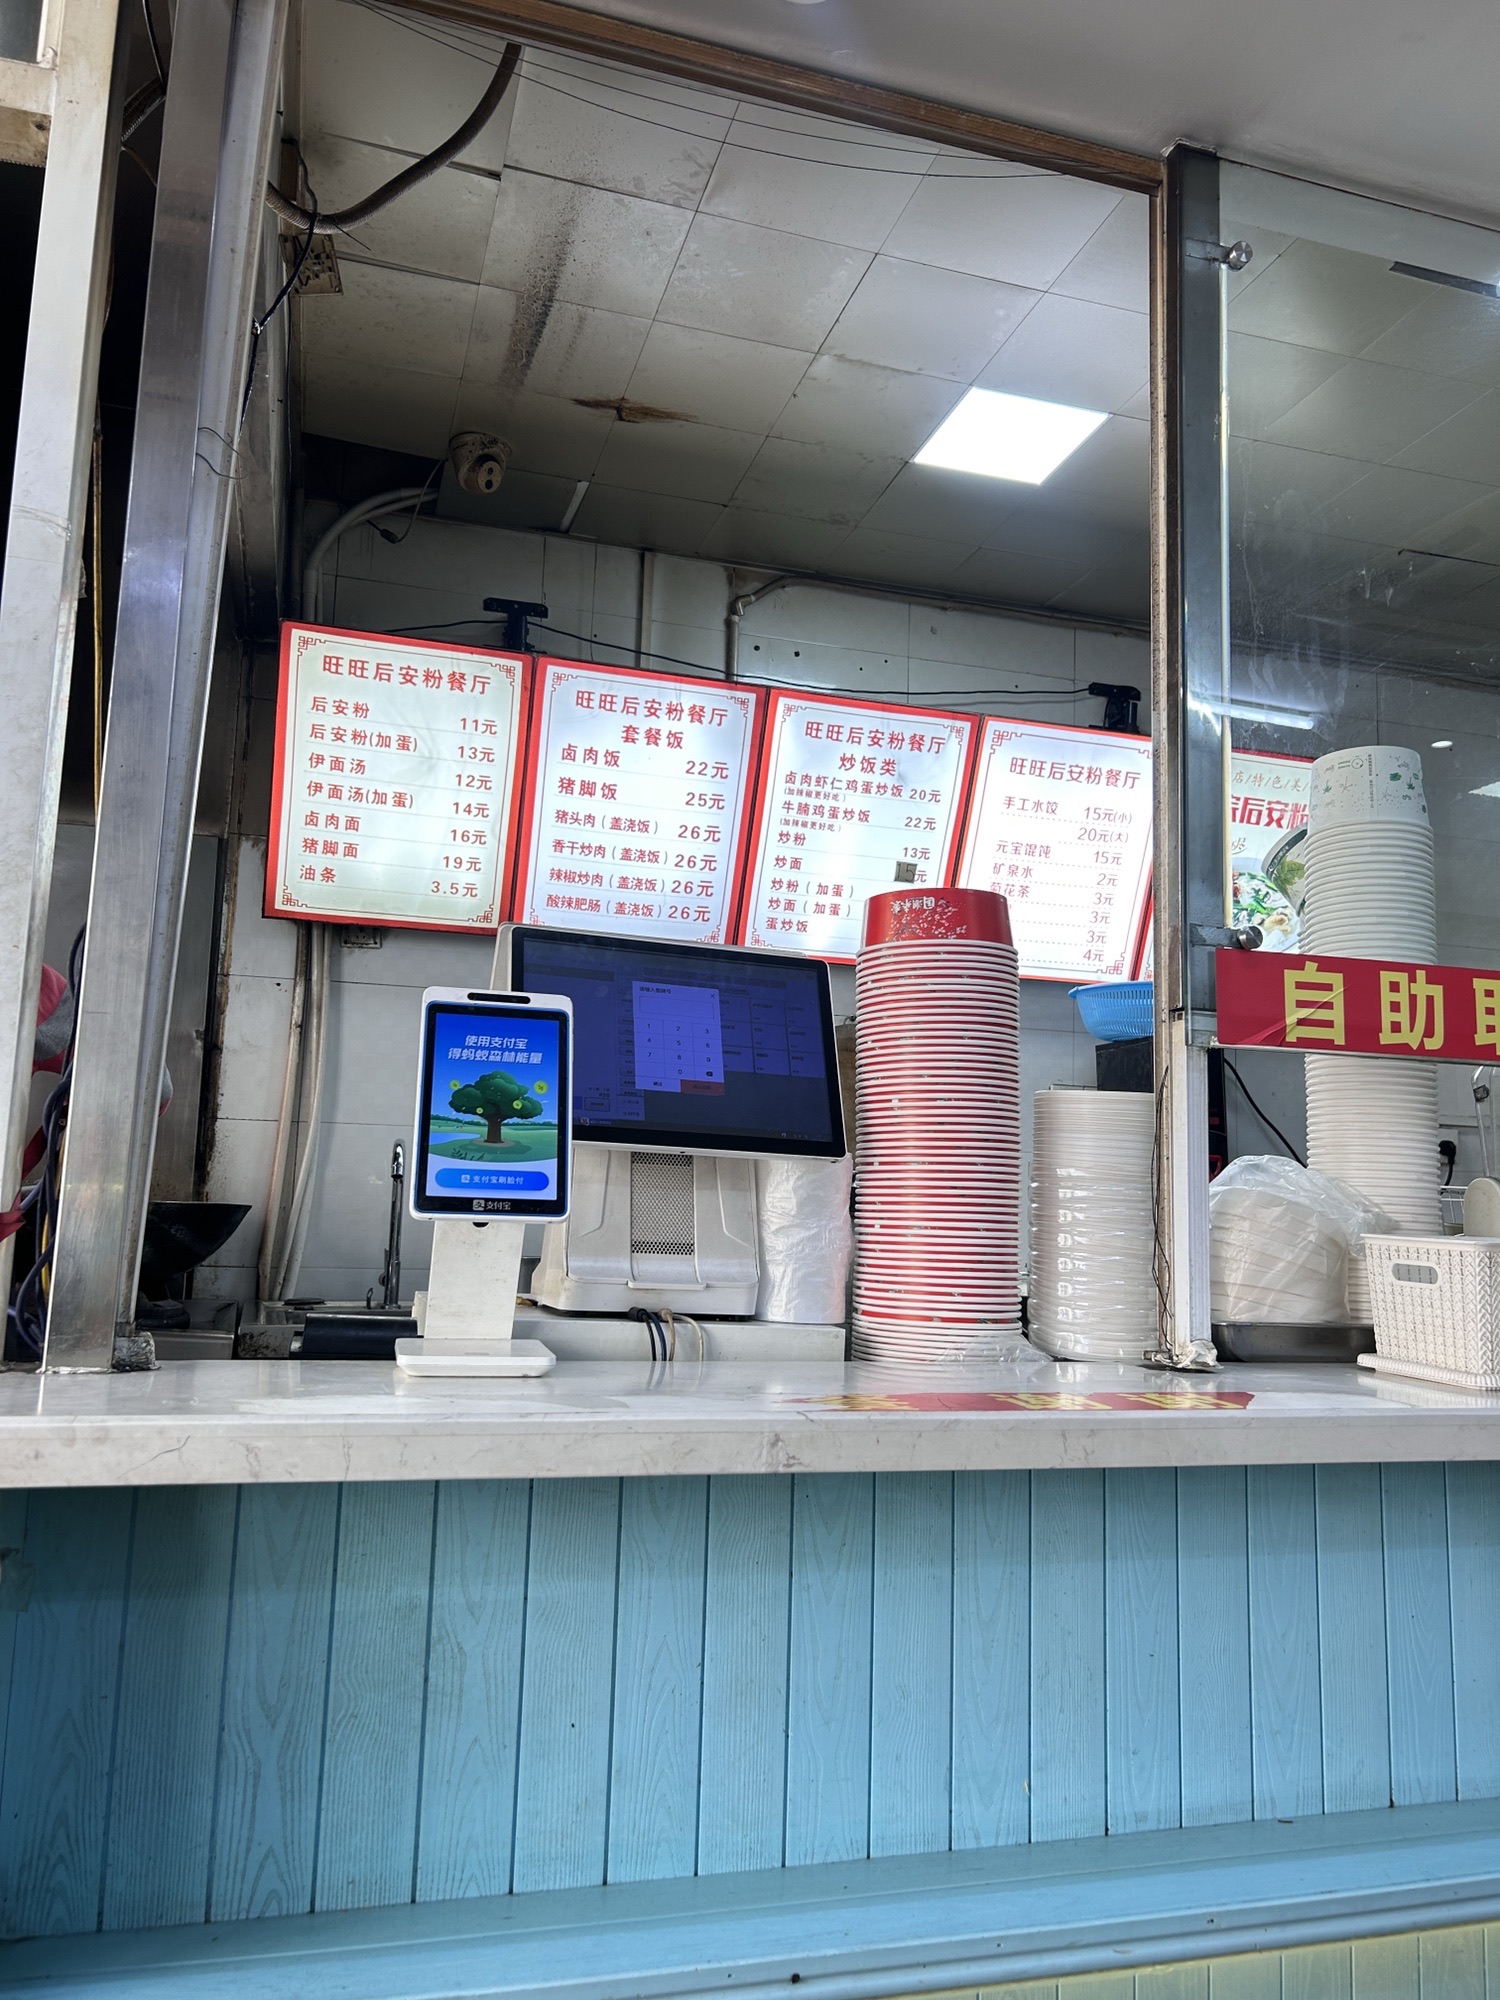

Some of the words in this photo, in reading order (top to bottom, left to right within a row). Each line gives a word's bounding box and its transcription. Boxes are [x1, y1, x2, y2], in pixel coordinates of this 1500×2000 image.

[322, 655, 491, 695] 旺旺后安粉餐厅
[310, 696, 370, 719] 后安粉
[460, 717, 497, 736] 11元
[575, 689, 728, 727] 旺旺后安粉餐厅
[309, 724, 418, 753] 后安粉(加蛋)
[457, 746, 495, 763] 13元
[621, 725, 684, 750] 套餐饭
[804, 721, 947, 755] 旺旺后安粉餐厅
[308, 752, 366, 775] 伊面汤
[455, 773, 493, 791] 12元
[561, 743, 621, 768] 卤肉饭
[686, 760, 729, 780] 22元
[838, 753, 897, 777] 炒饭类
[1009, 757, 1141, 790] 旺旺后安粉餐厅
[306, 780, 414, 809] 伊面汤(加蛋)
[452, 802, 490, 818] 14元
[558, 776, 618, 801] 猪脚饭
[685, 792, 725, 811] 25元
[784, 771, 903, 798] 卤肉虾仁鸡蛋炒饭
[909, 788, 942, 804] 20元
[781, 800, 871, 823] 牛腩鸡蛋炒饭
[904, 816, 937, 831] 22元
[1002, 795, 1059, 816] 手工水饺
[304, 811, 361, 832] 卤肉面
[450, 829, 487, 845] 16元
[678, 824, 722, 843] 26元
[302, 837, 359, 859] 猪脚面
[443, 856, 482, 872] 19元
[777, 830, 807, 847] 炒粉
[902, 847, 931, 861] 13元
[996, 840, 1051, 859] 元宝馄饨
[1093, 851, 1123, 866] 15元
[674, 853, 718, 872] 26元
[774, 855, 803, 871] 炒面
[993, 863, 1034, 879] 矿泉水
[1097, 873, 1119, 887] 2元
[299, 864, 337, 883] 油条
[431, 881, 479, 898] 3.5元
[671, 879, 714, 898] 26元
[1093, 892, 1115, 907] 3元
[668, 905, 711, 923] 26元
[765, 917, 809, 933] 蛋炒饭
[1089, 911, 1111, 925] 3元
[1086, 929, 1107, 944] 3元
[1083, 949, 1105, 963] 4元
[465, 1035, 528, 1050] 使用支付宝
[448, 1048, 543, 1065] 得蚂蚁森林能量
[472, 1175, 524, 1185] 支付宝刷脸付
[485, 1201, 511, 1211] 支付宝
